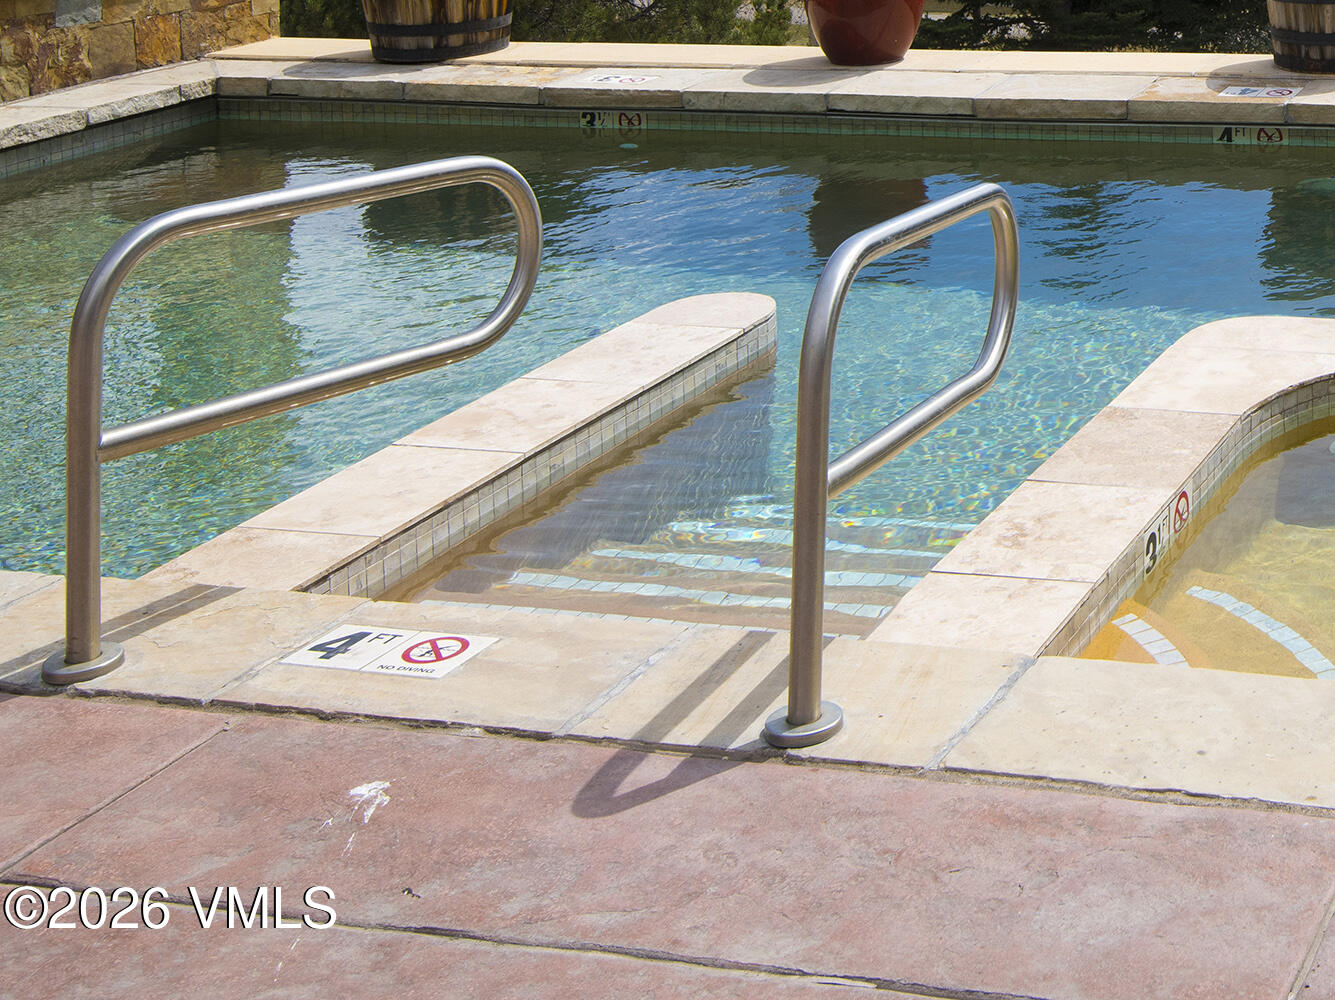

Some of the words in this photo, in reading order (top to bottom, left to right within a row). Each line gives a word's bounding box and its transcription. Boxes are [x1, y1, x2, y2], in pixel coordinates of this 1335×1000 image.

[1216, 127, 1236, 143] 4
[1145, 530, 1157, 574] 3
[307, 630, 374, 660] 4
[367, 633, 404, 645] FT
[377, 663, 396, 671] NO
[397, 664, 436, 674] DIVING
